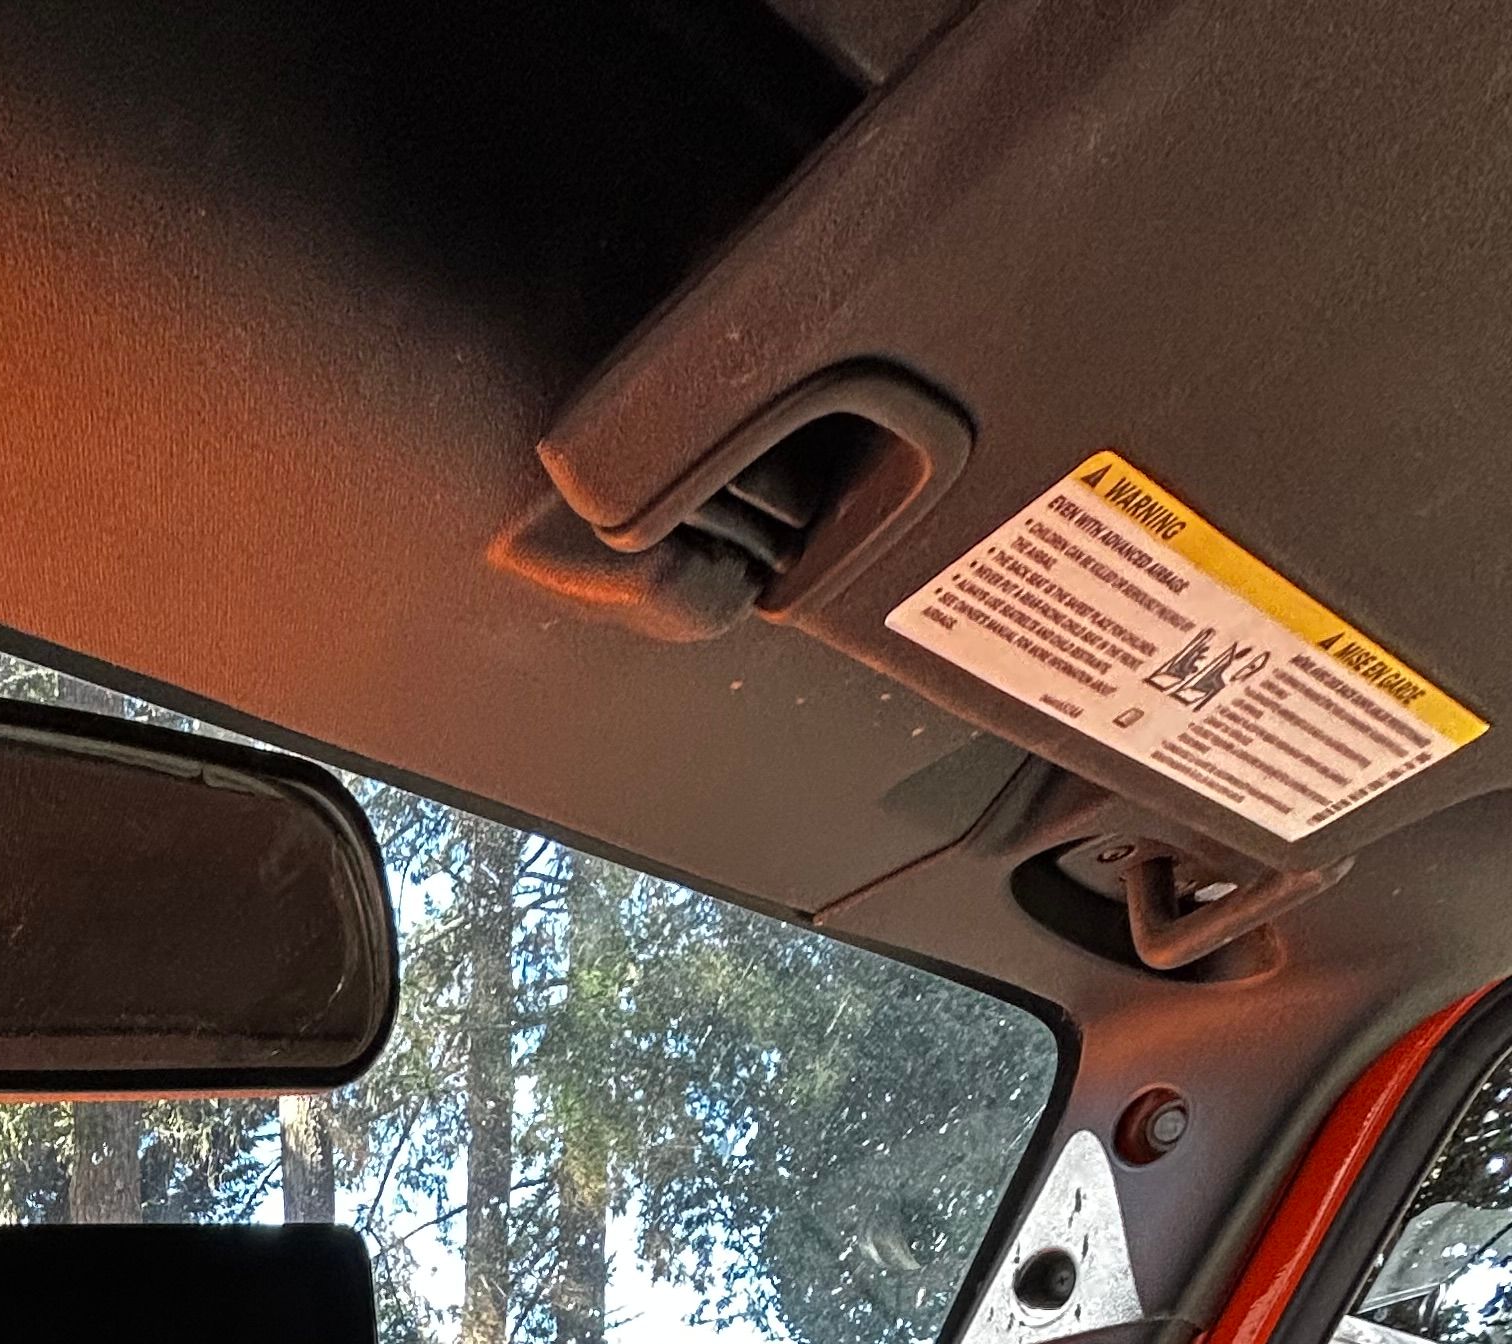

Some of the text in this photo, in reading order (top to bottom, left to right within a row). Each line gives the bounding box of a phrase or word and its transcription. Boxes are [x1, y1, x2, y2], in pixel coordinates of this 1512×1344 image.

[1047, 496, 1081, 519] EVEN
[1073, 513, 1106, 536] WITH
[1098, 530, 1154, 568] ADVANCED
[1104, 478, 1187, 541] WARNING
[1064, 546, 1084, 560] CAN
[1337, 643, 1425, 705] MISE EN GARDE
